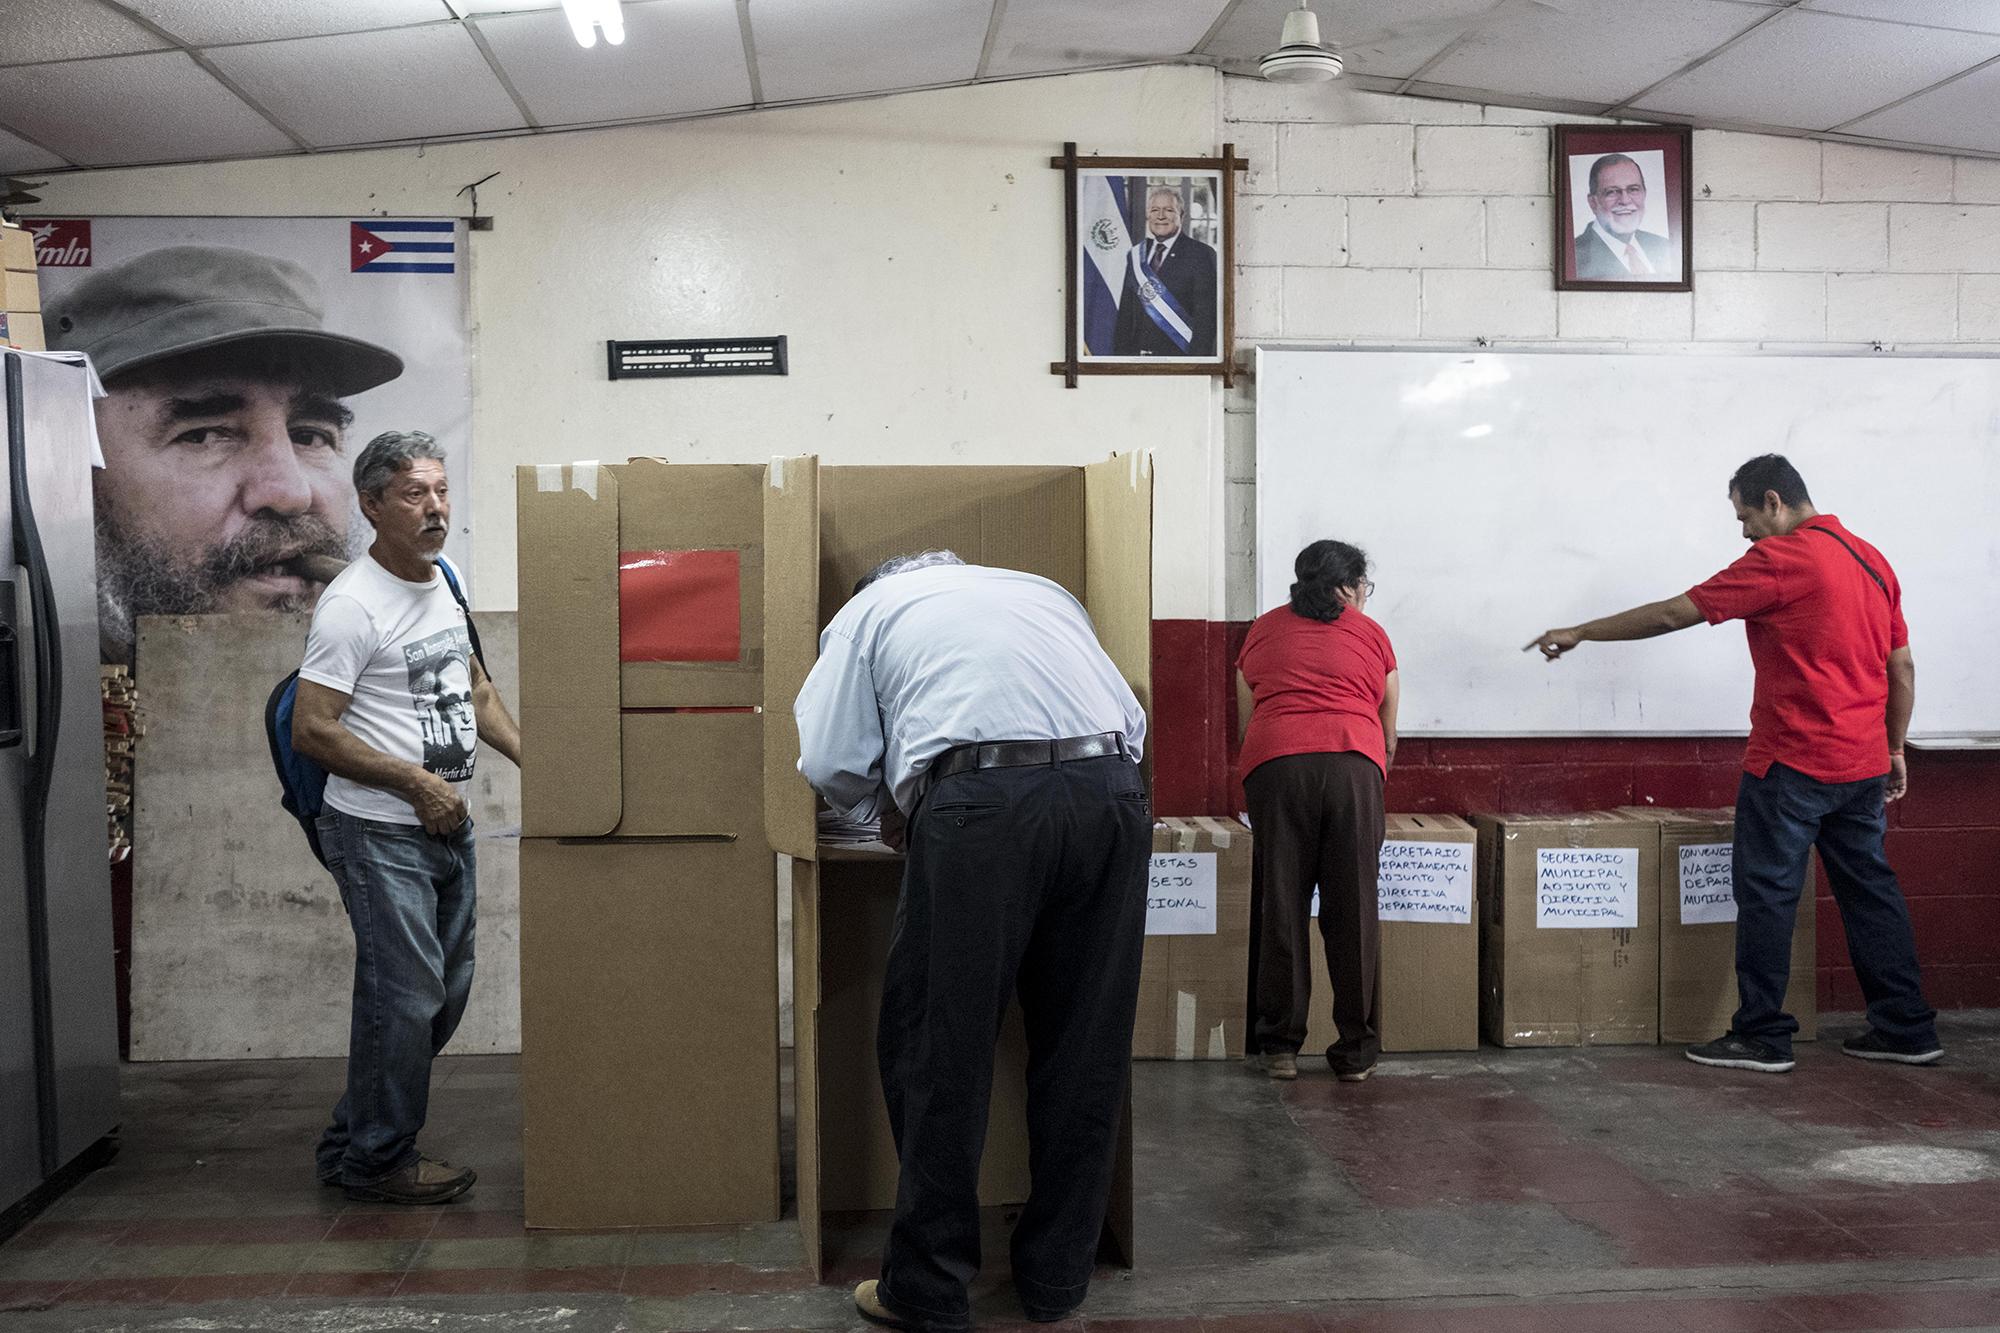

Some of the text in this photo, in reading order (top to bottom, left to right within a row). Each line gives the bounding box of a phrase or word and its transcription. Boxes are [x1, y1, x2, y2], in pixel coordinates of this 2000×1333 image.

[405, 648, 425, 663] San
[1541, 852, 1624, 864] SECRETARIO
[1379, 860, 1469, 872] EPARTAMENTAL
[1683, 863, 1731, 876] NACIO
[1541, 868, 1623, 879] MUNICIPAL
[1151, 876, 1193, 888] SEJO
[1445, 875, 1455, 885] Y
[1685, 876, 1732, 889] DEPAR
[1377, 887, 1447, 898] DIRECTIVA
[1542, 882, 1628, 893] ADJUNTO Y
[1147, 897, 1207, 909] CIONAL
[1541, 894, 1620, 905] DIRECTIVA
[1543, 907, 1624, 918] MUNICIPAL
